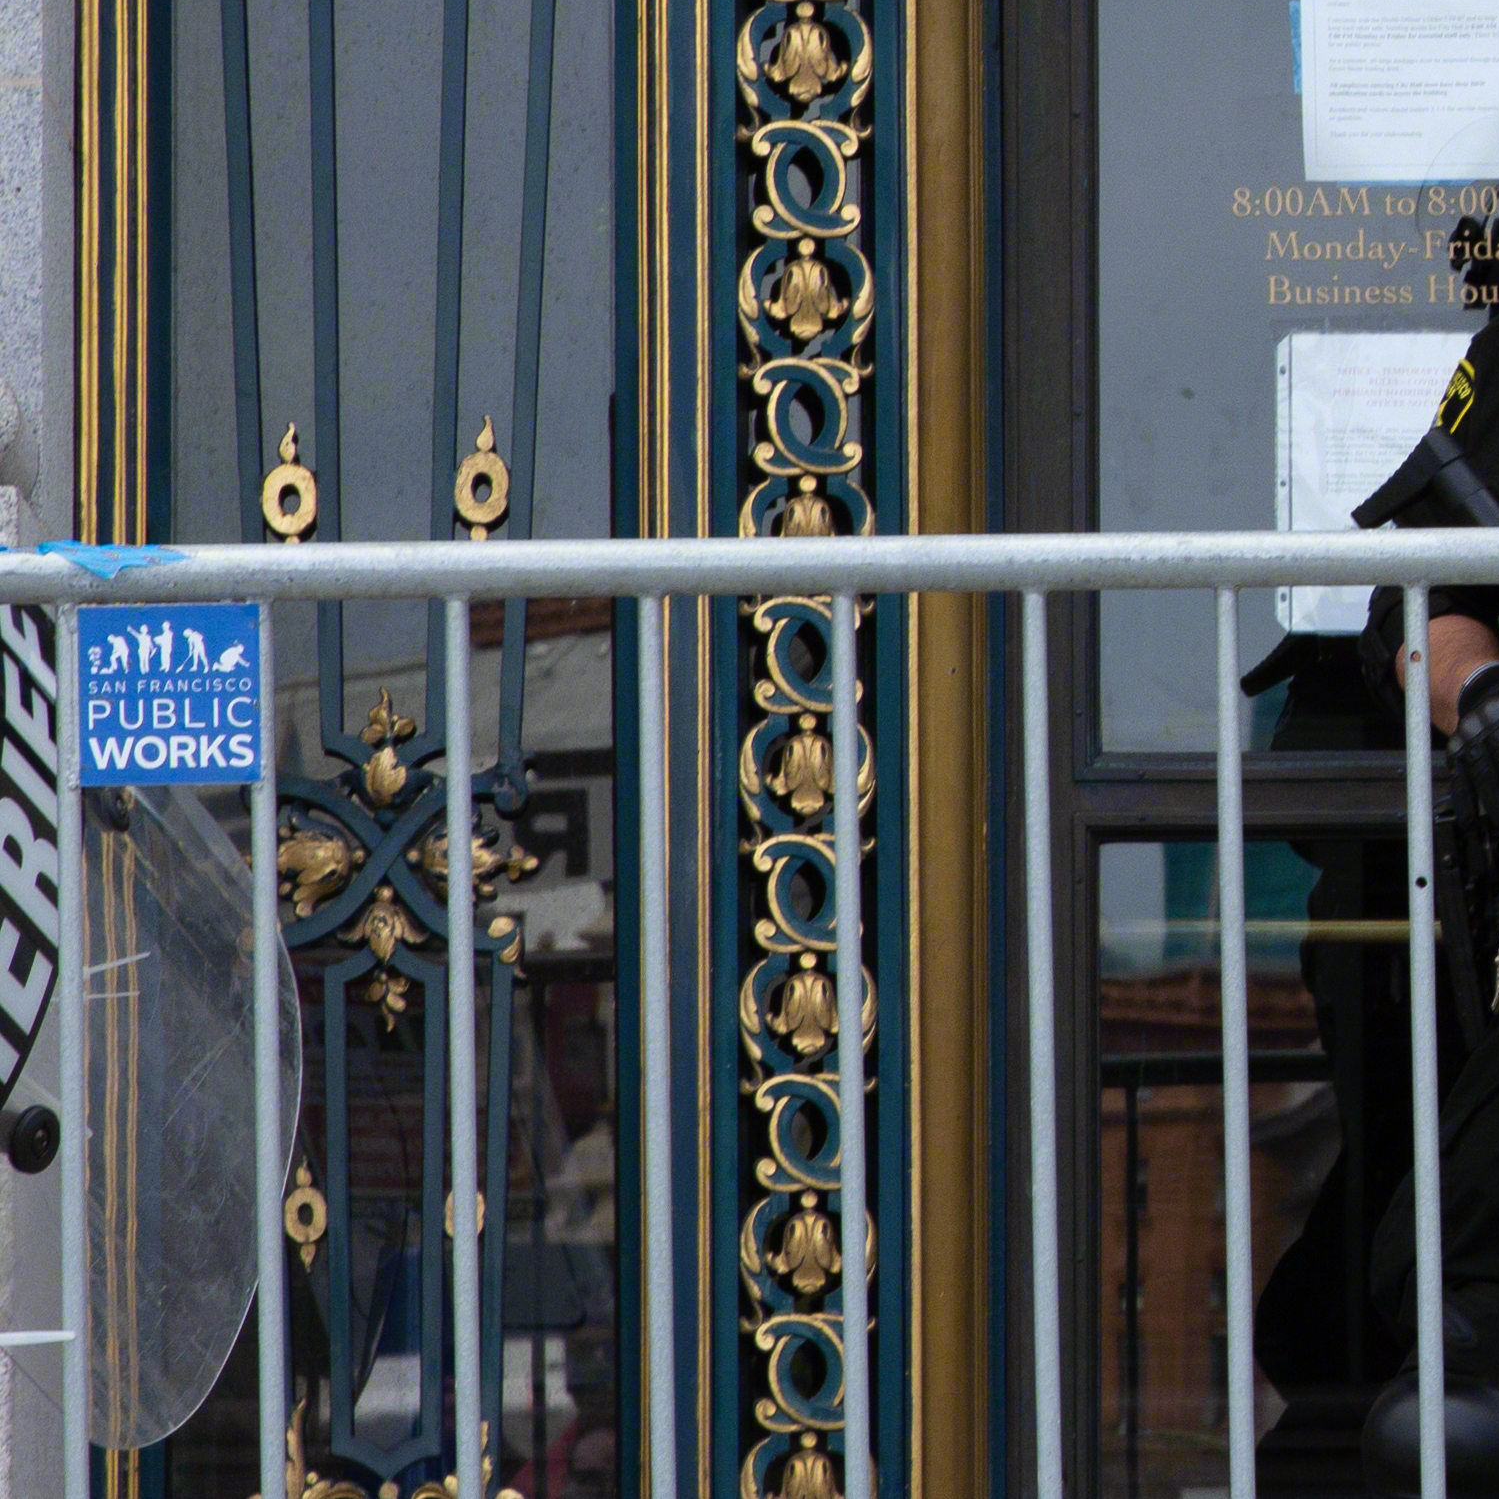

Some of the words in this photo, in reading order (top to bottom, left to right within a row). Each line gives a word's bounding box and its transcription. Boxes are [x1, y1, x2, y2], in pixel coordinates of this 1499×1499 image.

[1232, 187, 1371, 217] 8:00AM
[1385, 188, 1417, 217] to
[1268, 274, 1413, 305] Business
[88, 679, 126, 695] SAN
[138, 677, 252, 694] FRANCISCO
[88, 696, 253, 731] PUBLIC
[88, 733, 255, 770] WORKS
